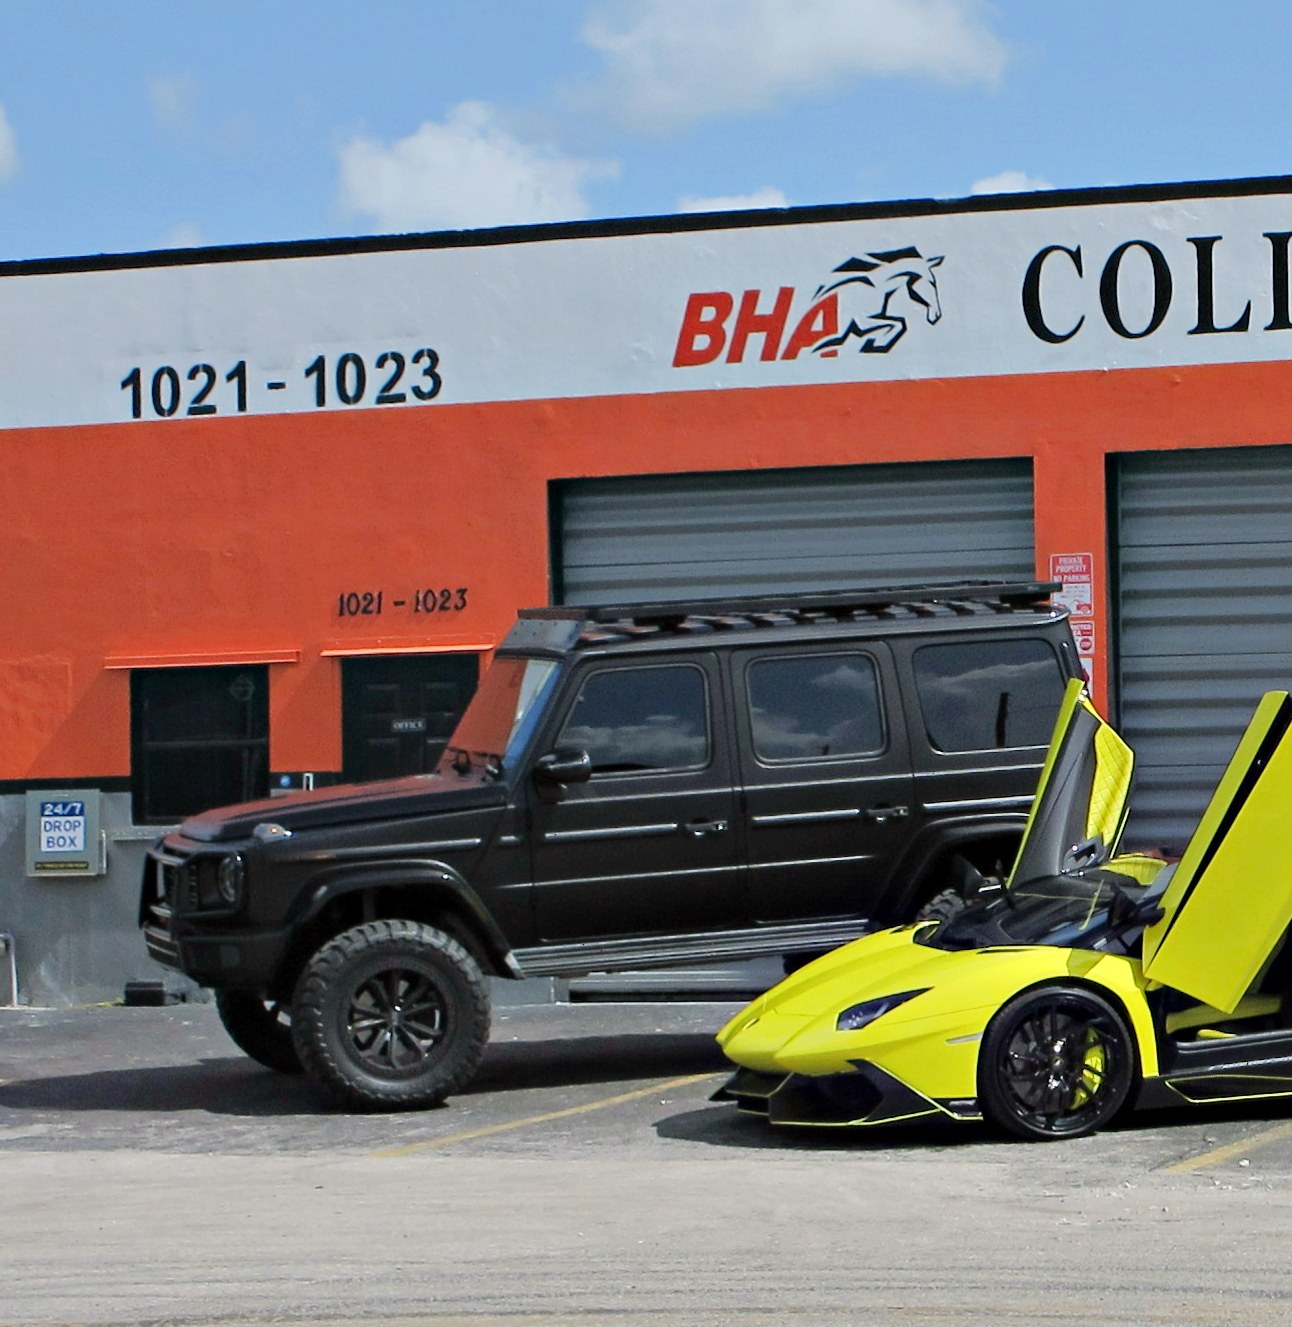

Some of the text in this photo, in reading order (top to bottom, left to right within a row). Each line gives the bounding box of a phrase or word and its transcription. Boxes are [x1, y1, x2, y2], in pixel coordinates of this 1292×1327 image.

[672, 286, 838, 367] BHA
[120, 360, 247, 419] 1021
[304, 348, 442, 408] 1023
[338, 591, 383, 617] 1021
[413, 588, 468, 613] 1023
[43, 803, 82, 815] 24/7
[43, 820, 81, 832] DROP
[46, 836, 77, 848] BOX
